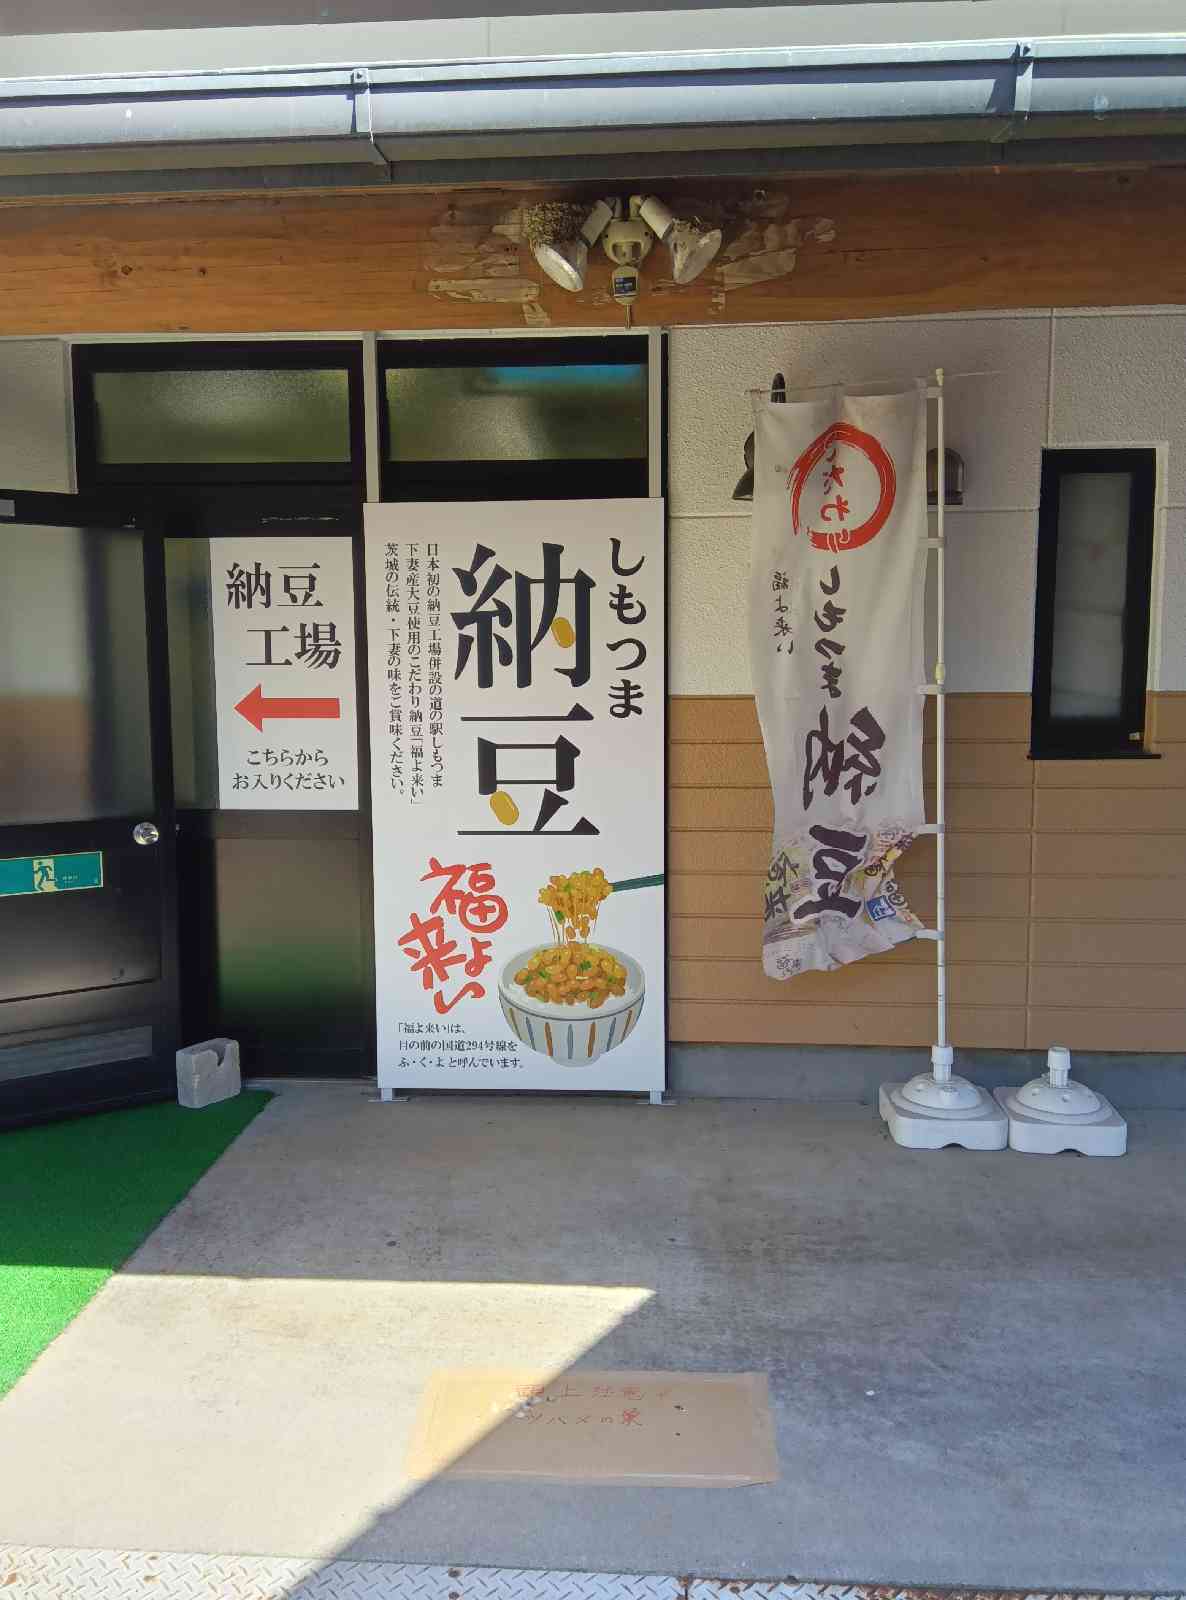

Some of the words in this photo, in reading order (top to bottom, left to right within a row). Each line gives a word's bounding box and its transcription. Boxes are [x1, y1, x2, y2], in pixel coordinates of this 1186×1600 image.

[225, 561, 324, 609] 納豆
[606, 537, 647, 719] しもつま
[245, 622, 342, 670] 工場
[384, 543, 404, 796] 茨城の伝統・下妻の味をご賞味ください。
[405, 543, 424, 805] 下妻産大豆使用のこだわり納豆「福よ来い」
[426, 543, 443, 788] 日本初の納豆工場併設の道の駅しもつま
[450, 542, 600, 835] 納豆
[232, 772, 345, 791] お入りください
[246, 749, 328, 767] こちらから
[399, 1039, 518, 1052] 目の前の国道294号線を
